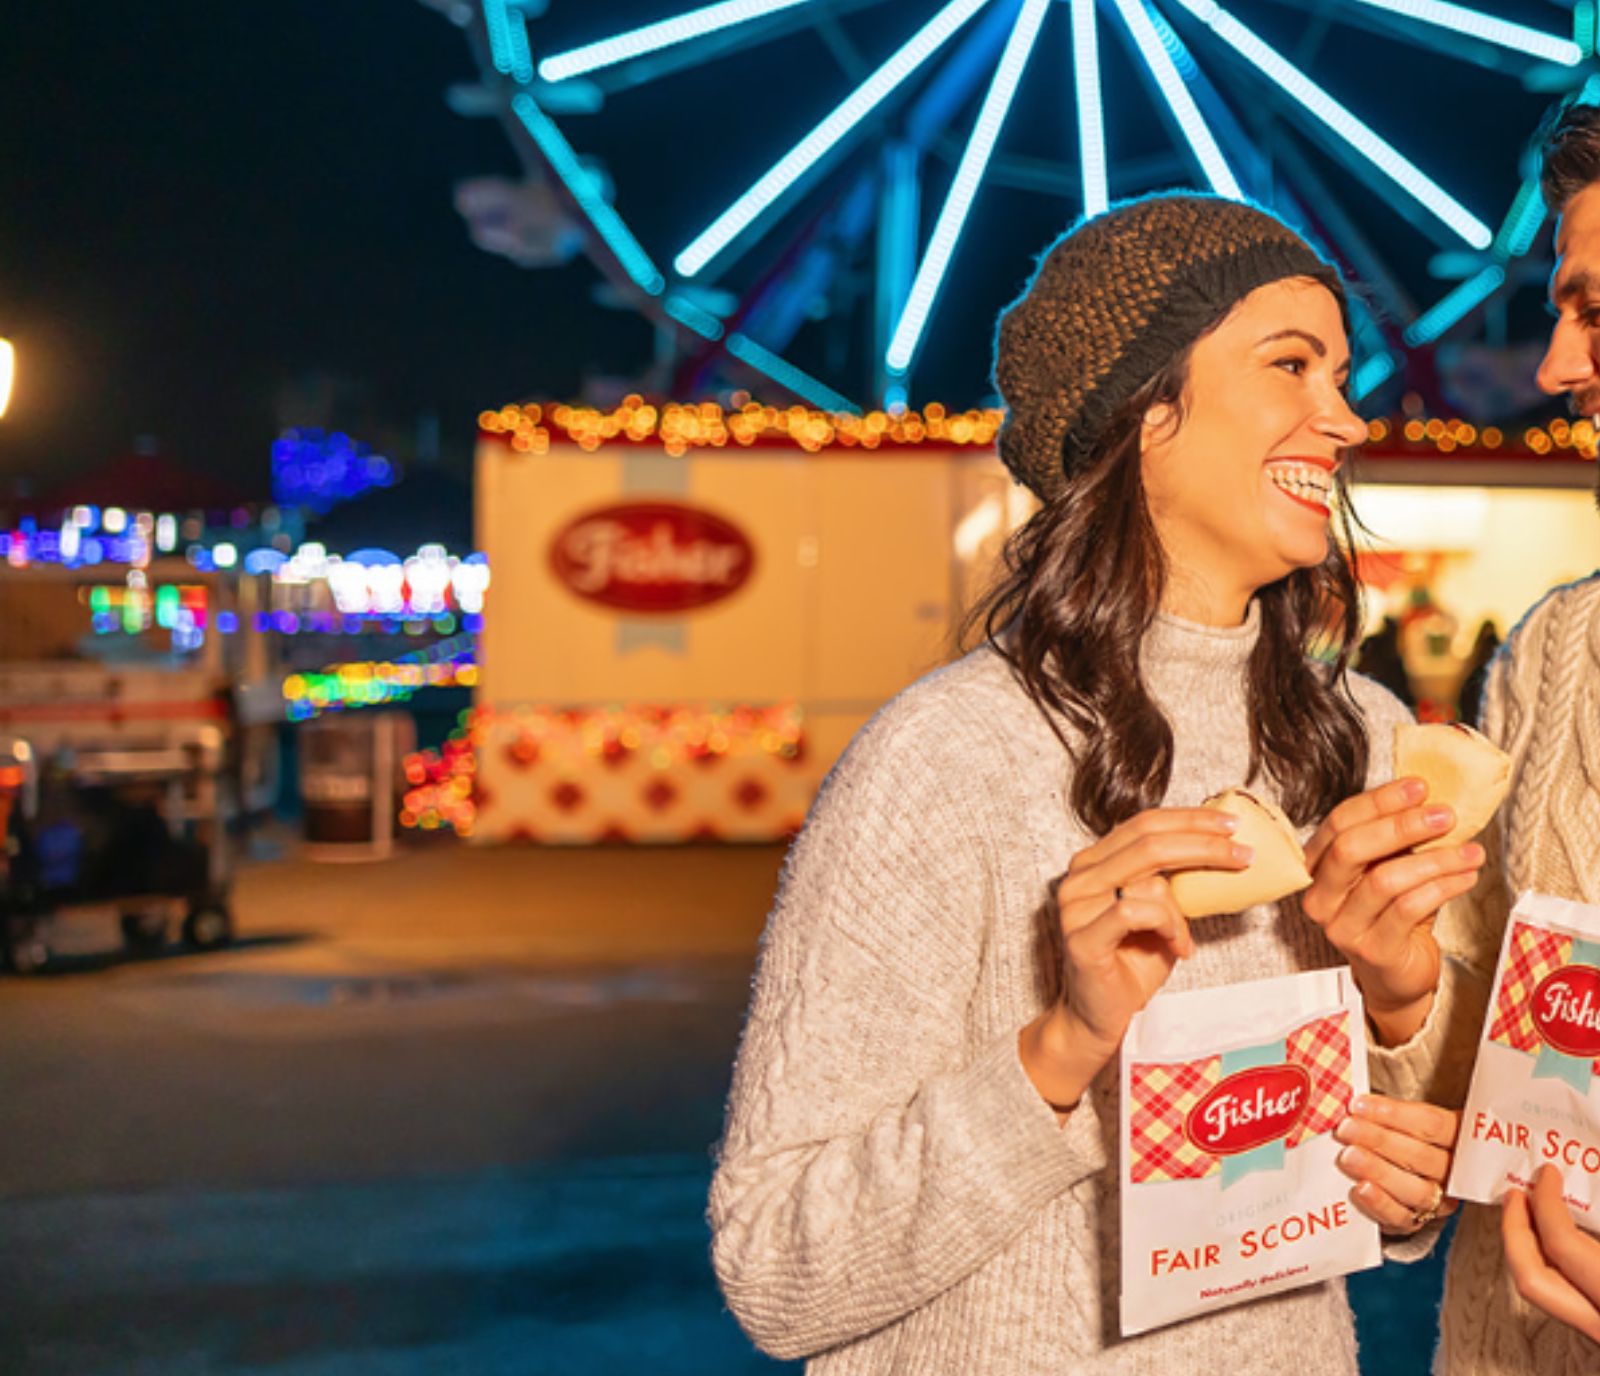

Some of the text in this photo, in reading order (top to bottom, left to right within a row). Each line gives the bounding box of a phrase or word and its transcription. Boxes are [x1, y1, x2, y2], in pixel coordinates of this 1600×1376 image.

[1203, 1086, 1303, 1143] Fisher
[1472, 1112, 1530, 1150] FAIR
[1150, 1201, 1349, 1277] FAIR SCONE
